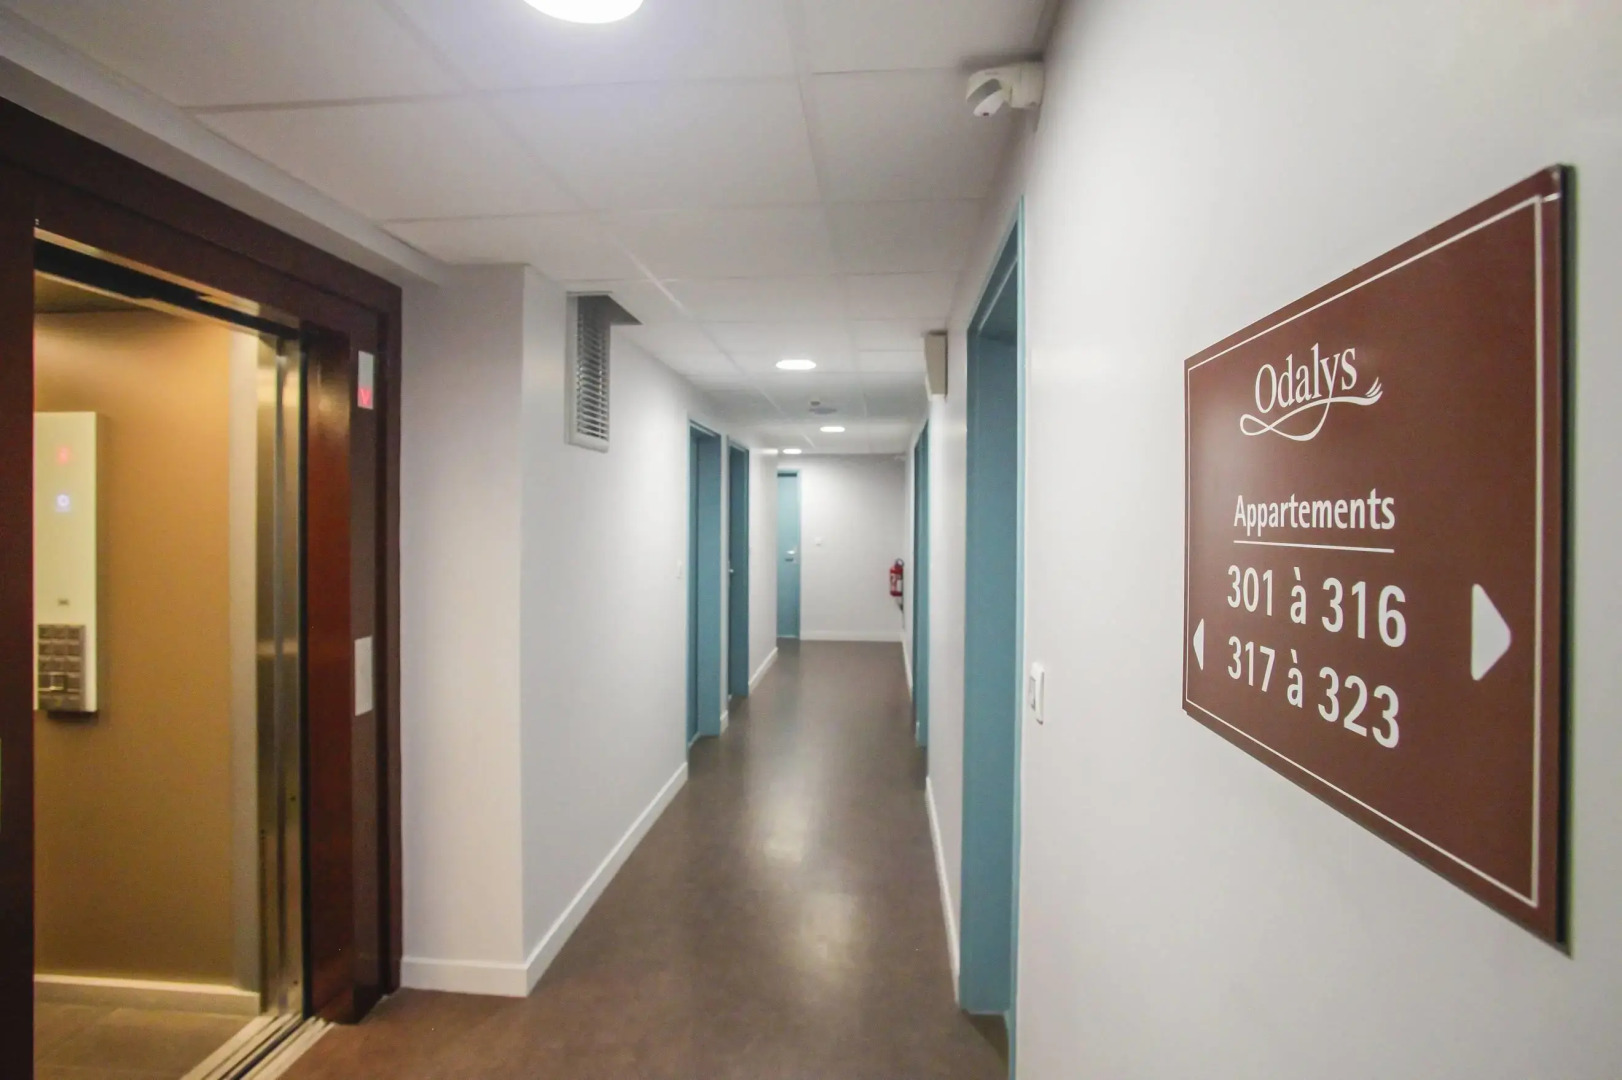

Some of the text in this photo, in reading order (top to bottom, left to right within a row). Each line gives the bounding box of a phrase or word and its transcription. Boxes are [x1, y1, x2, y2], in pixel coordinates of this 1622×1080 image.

[1254, 342, 1359, 416] Odalys
[1233, 488, 1396, 537] Appartements
[1227, 564, 1407, 648] 301 à 316
[1227, 635, 1400, 749] 317 à 323
